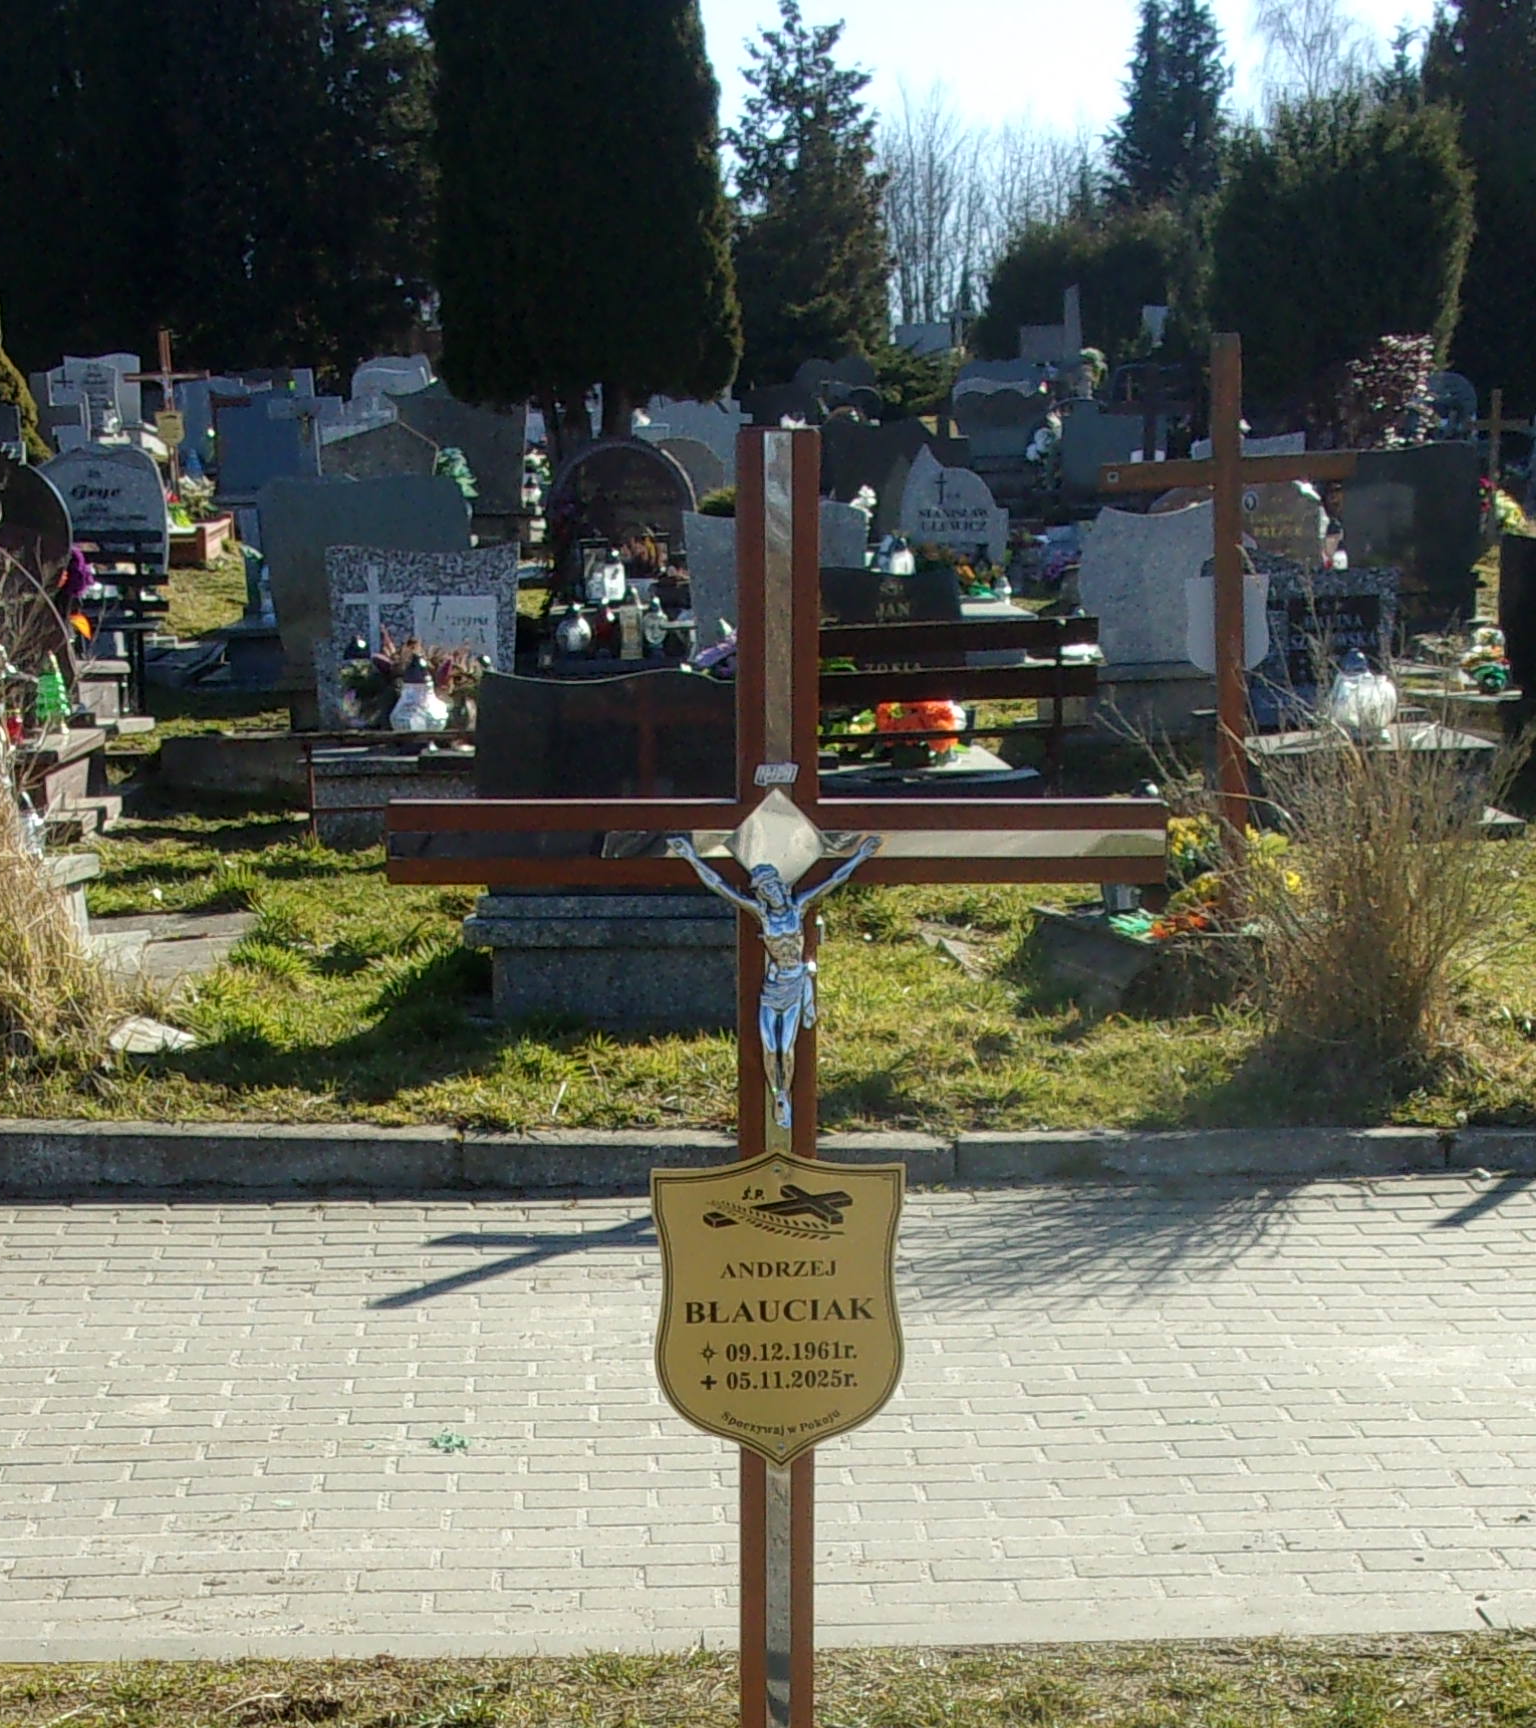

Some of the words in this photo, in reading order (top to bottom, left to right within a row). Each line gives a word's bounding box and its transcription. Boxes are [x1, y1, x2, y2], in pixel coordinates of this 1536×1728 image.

[720, 1260, 837, 1279] ANDRZEJ
[685, 1297, 875, 1325] BŁAUCIAK
[725, 1341, 858, 1363] 09.12.1961r.
[726, 1370, 858, 1391] 05.11.2025r.
